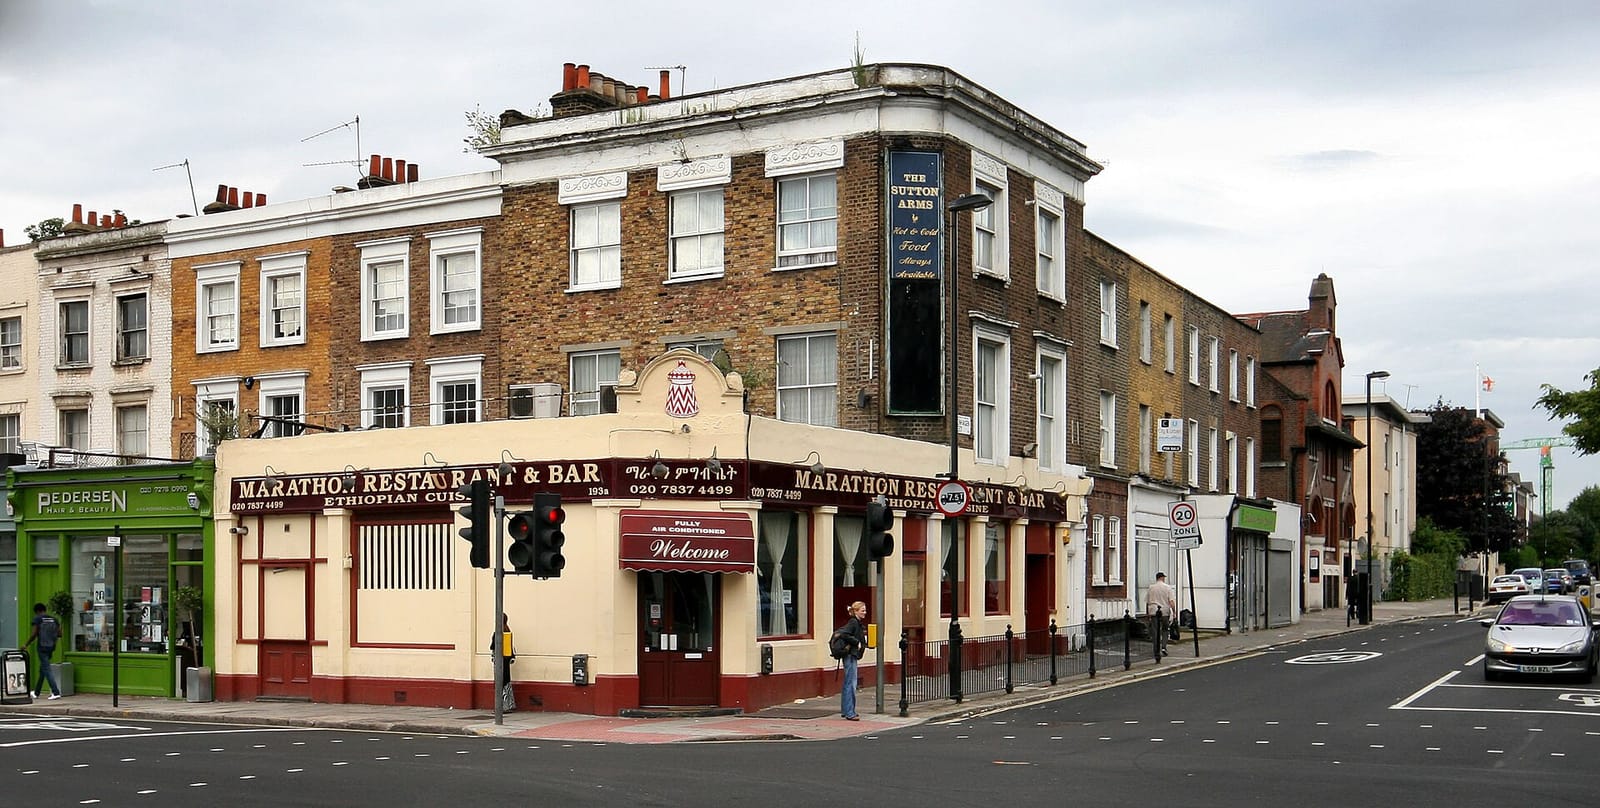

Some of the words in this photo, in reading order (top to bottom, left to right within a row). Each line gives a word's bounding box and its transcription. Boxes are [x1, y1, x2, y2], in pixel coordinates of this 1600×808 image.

[904, 174, 926, 182] THE
[891, 186, 939, 196] SUTTON
[898, 200, 934, 209] ARMS
[894, 227, 908, 235] Hot
[920, 228, 939, 236] Cold
[899, 240, 931, 251] Food
[899, 257, 932, 267] Always
[895, 270, 936, 278] Available
[523, 467, 540, 484] &
[548, 464, 600, 484] BAR
[588, 487, 609, 496] 193a
[630, 485, 656, 494] 020
[661, 485, 695, 495] 7837
[698, 485, 733, 495] 4499
[794, 470, 899, 496] MARATHON
[1007, 490, 1016, 505] &
[751, 487, 765, 498] 020
[766, 488, 783, 499] 7837
[784, 490, 802, 500] 4499
[38, 490, 127, 514] PEDERSEN
[324, 493, 418, 507] ETHIOPIAN
[232, 503, 246, 511] 020
[247, 501, 264, 510] 7837
[265, 500, 284, 509] 4499
[1175, 510, 1192, 521] 20
[1174, 527, 1196, 535] ZONE
[650, 539, 729, 559] Welcome
